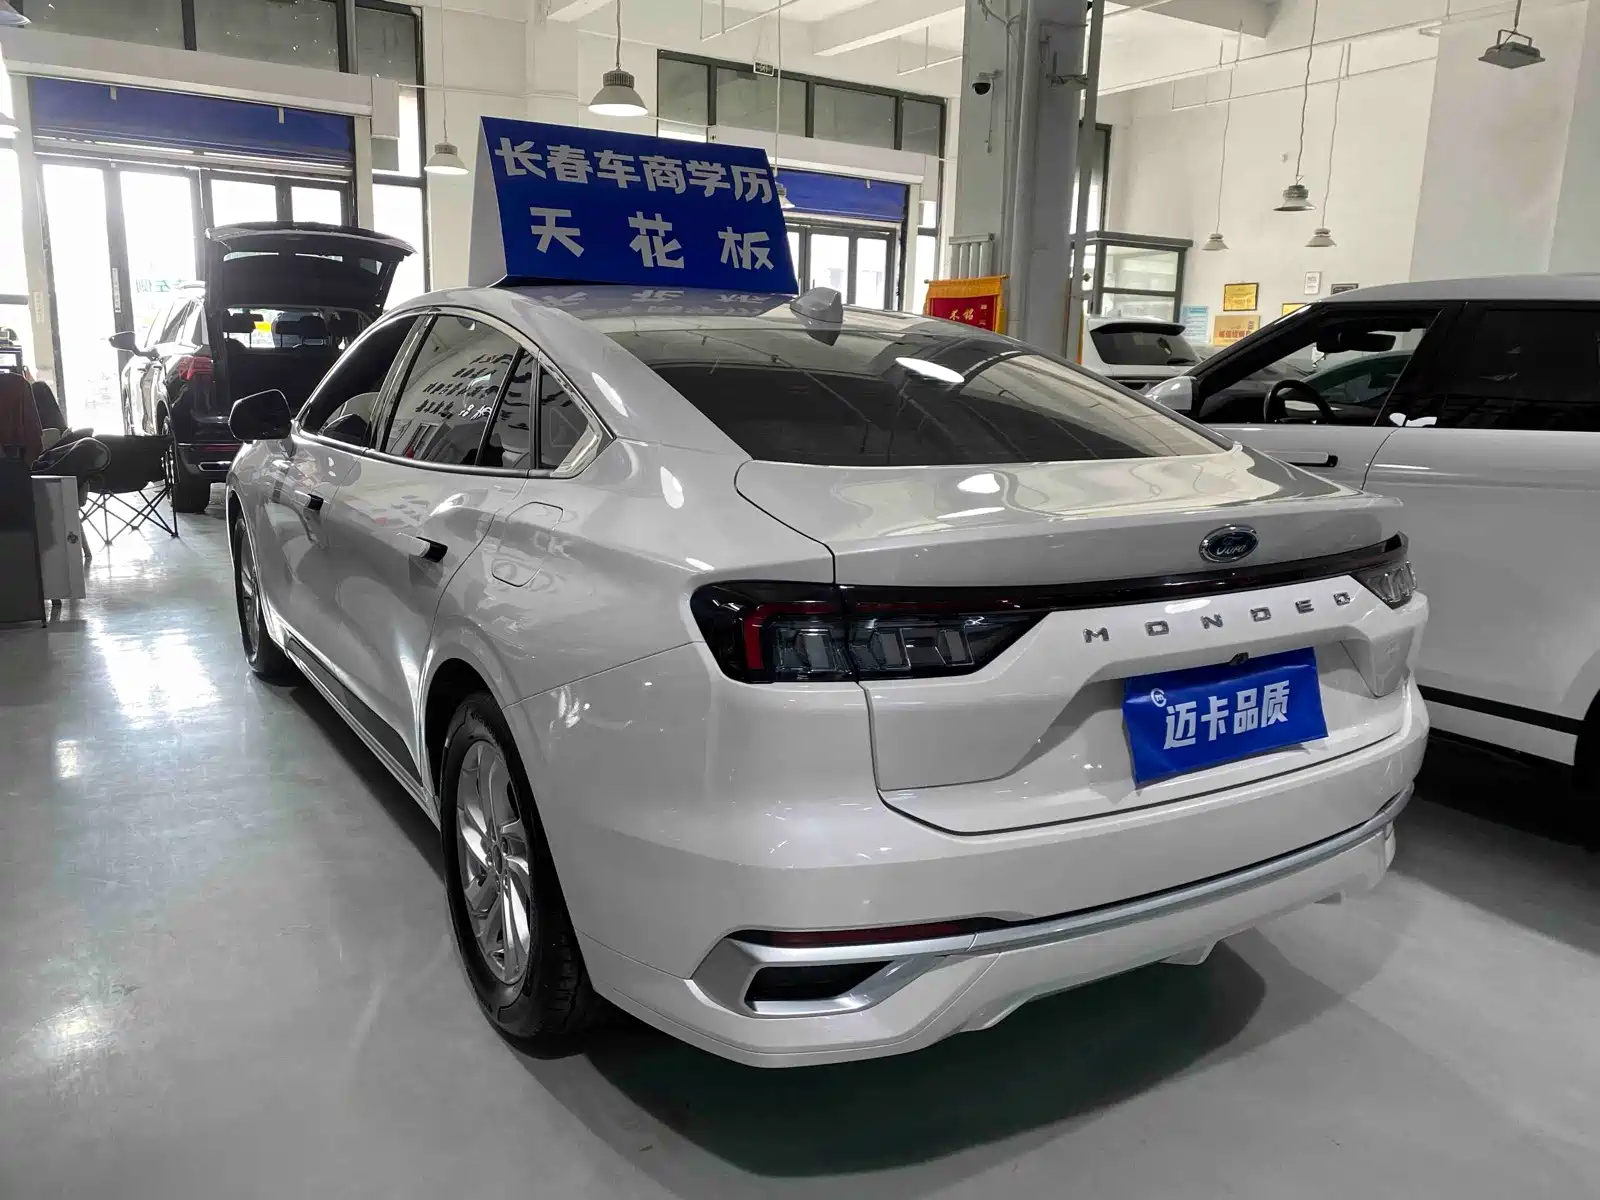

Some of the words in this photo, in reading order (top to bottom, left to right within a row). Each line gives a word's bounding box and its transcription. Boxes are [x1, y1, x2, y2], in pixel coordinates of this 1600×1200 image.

[495, 137, 773, 203] 长春车商学历
[529, 206, 774, 270] 天花板
[1082, 591, 1351, 643] MONDEO
[1163, 679, 1291, 750] 迈卡品质
